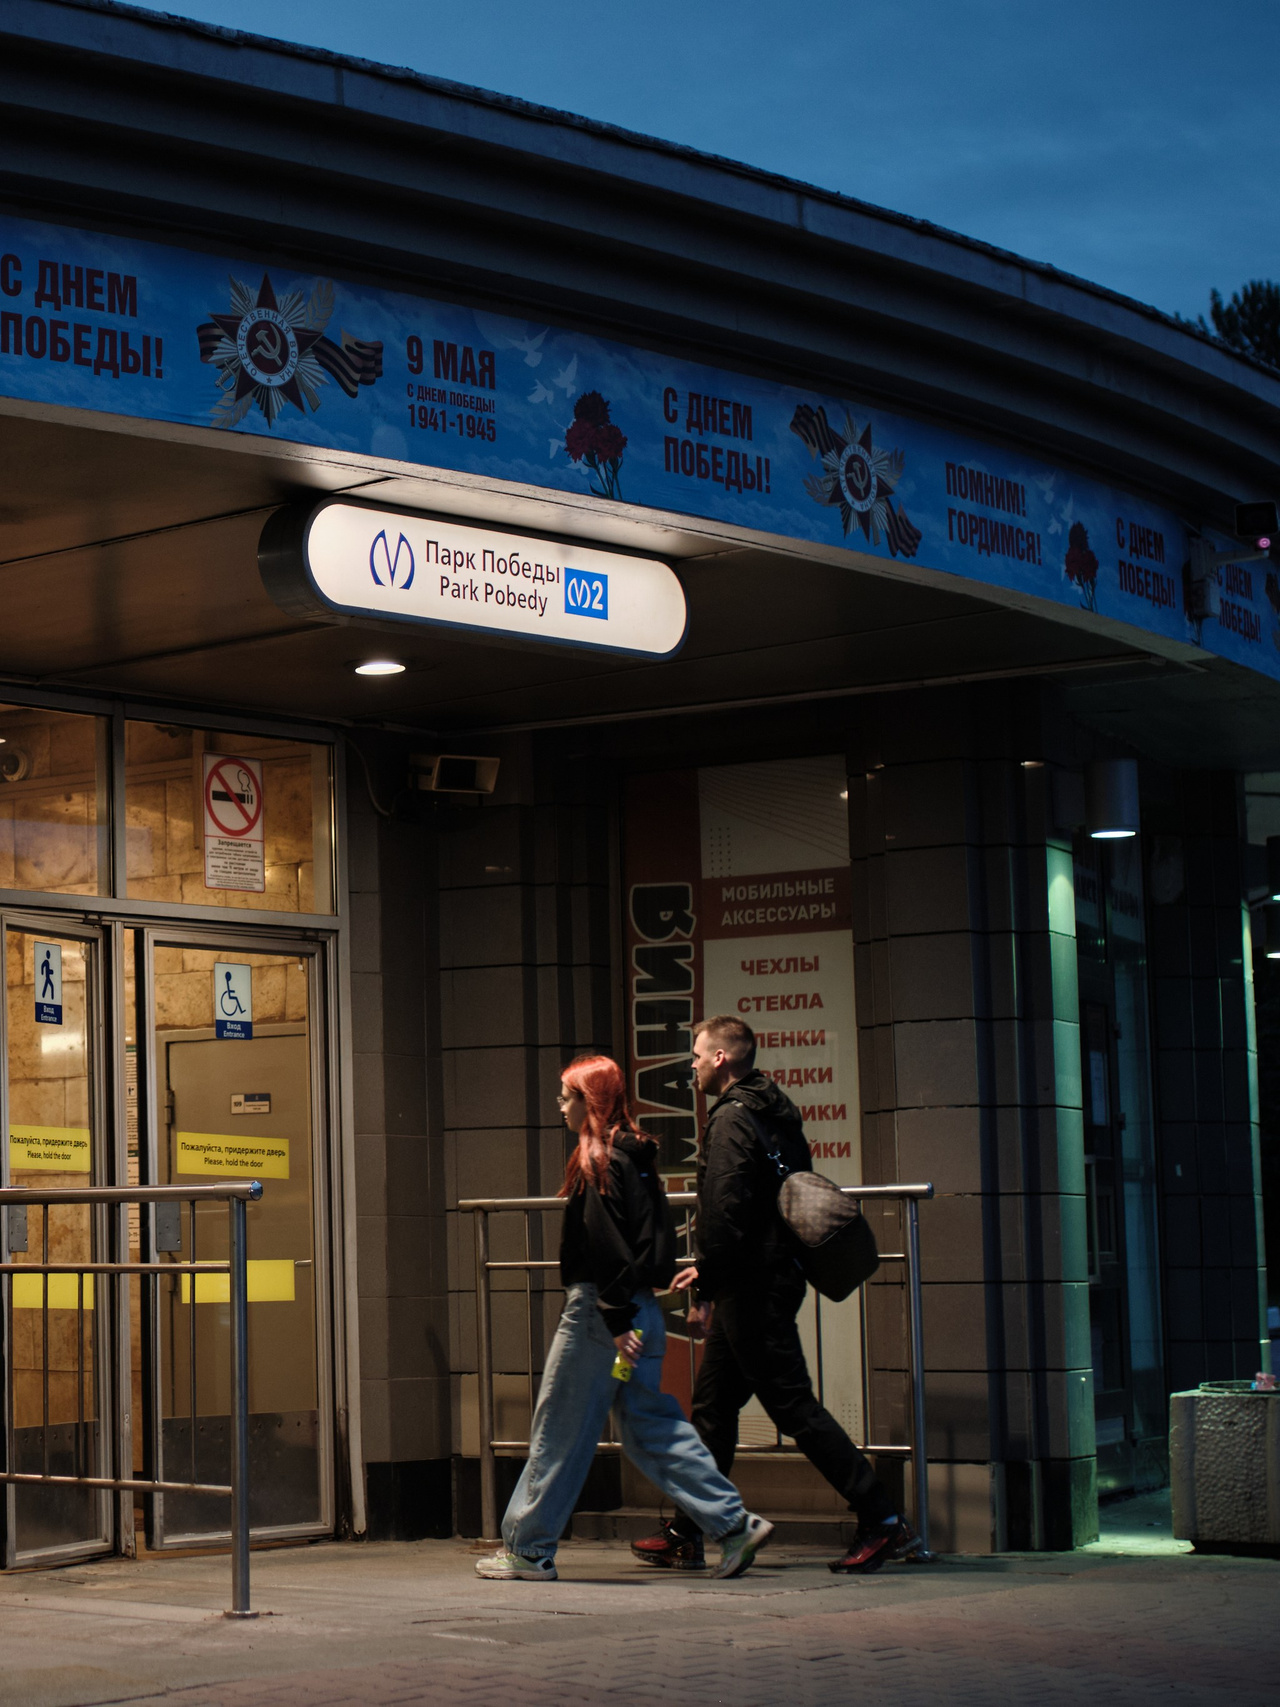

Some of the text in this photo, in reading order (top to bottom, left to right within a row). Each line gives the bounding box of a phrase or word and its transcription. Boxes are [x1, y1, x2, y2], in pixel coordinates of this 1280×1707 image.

[0, 253, 139, 319] С ДНЕМ
[0, 311, 165, 380] ПОБЕДЫ!
[239, 310, 291, 376] ОТЕЧЕСТВЕННАЯ
[406, 335, 496, 391] 9 МАЯ
[407, 382, 496, 415] С ДНЕМ ПОБЕДЫ!
[663, 387, 752, 441] С ДНЕМ
[407, 404, 497, 444] 1941-1945
[664, 435, 770, 494] ПОБЕДЫ!
[945, 461, 1026, 518] ПОМНИМ!
[947, 507, 1042, 566] ГОРДИМСЯ!
[1116, 517, 1165, 564] С ДНЕМ
[425, 539, 560, 585] Парк Победы
[439, 575, 548, 618] Park Pobedy
[1119, 559, 1176, 610] ПОБЕДЫ!
[1225, 564, 1253, 601] ДНЕМ
[721, 877, 835, 903] МОБИЛЬНЫЕ
[721, 902, 836, 927] АКСЕССУАРЫ
[740, 955, 819, 976] ЧЕХЛЫ
[737, 992, 824, 1014] СТЕКЛА
[223, 1030, 246, 1039] Entrance
[226, 1022, 241, 1031] Вход
[755, 1029, 826, 1048] ЛЕНКИ
[9, 1134, 88, 1149] Пожалуйста, придержите дверь
[27, 1151, 71, 1161] Please, hold the door
[180, 1143, 286, 1158] Пожалуйста, придержите дверь
[204, 1157, 263, 1169] Please, hold the door
